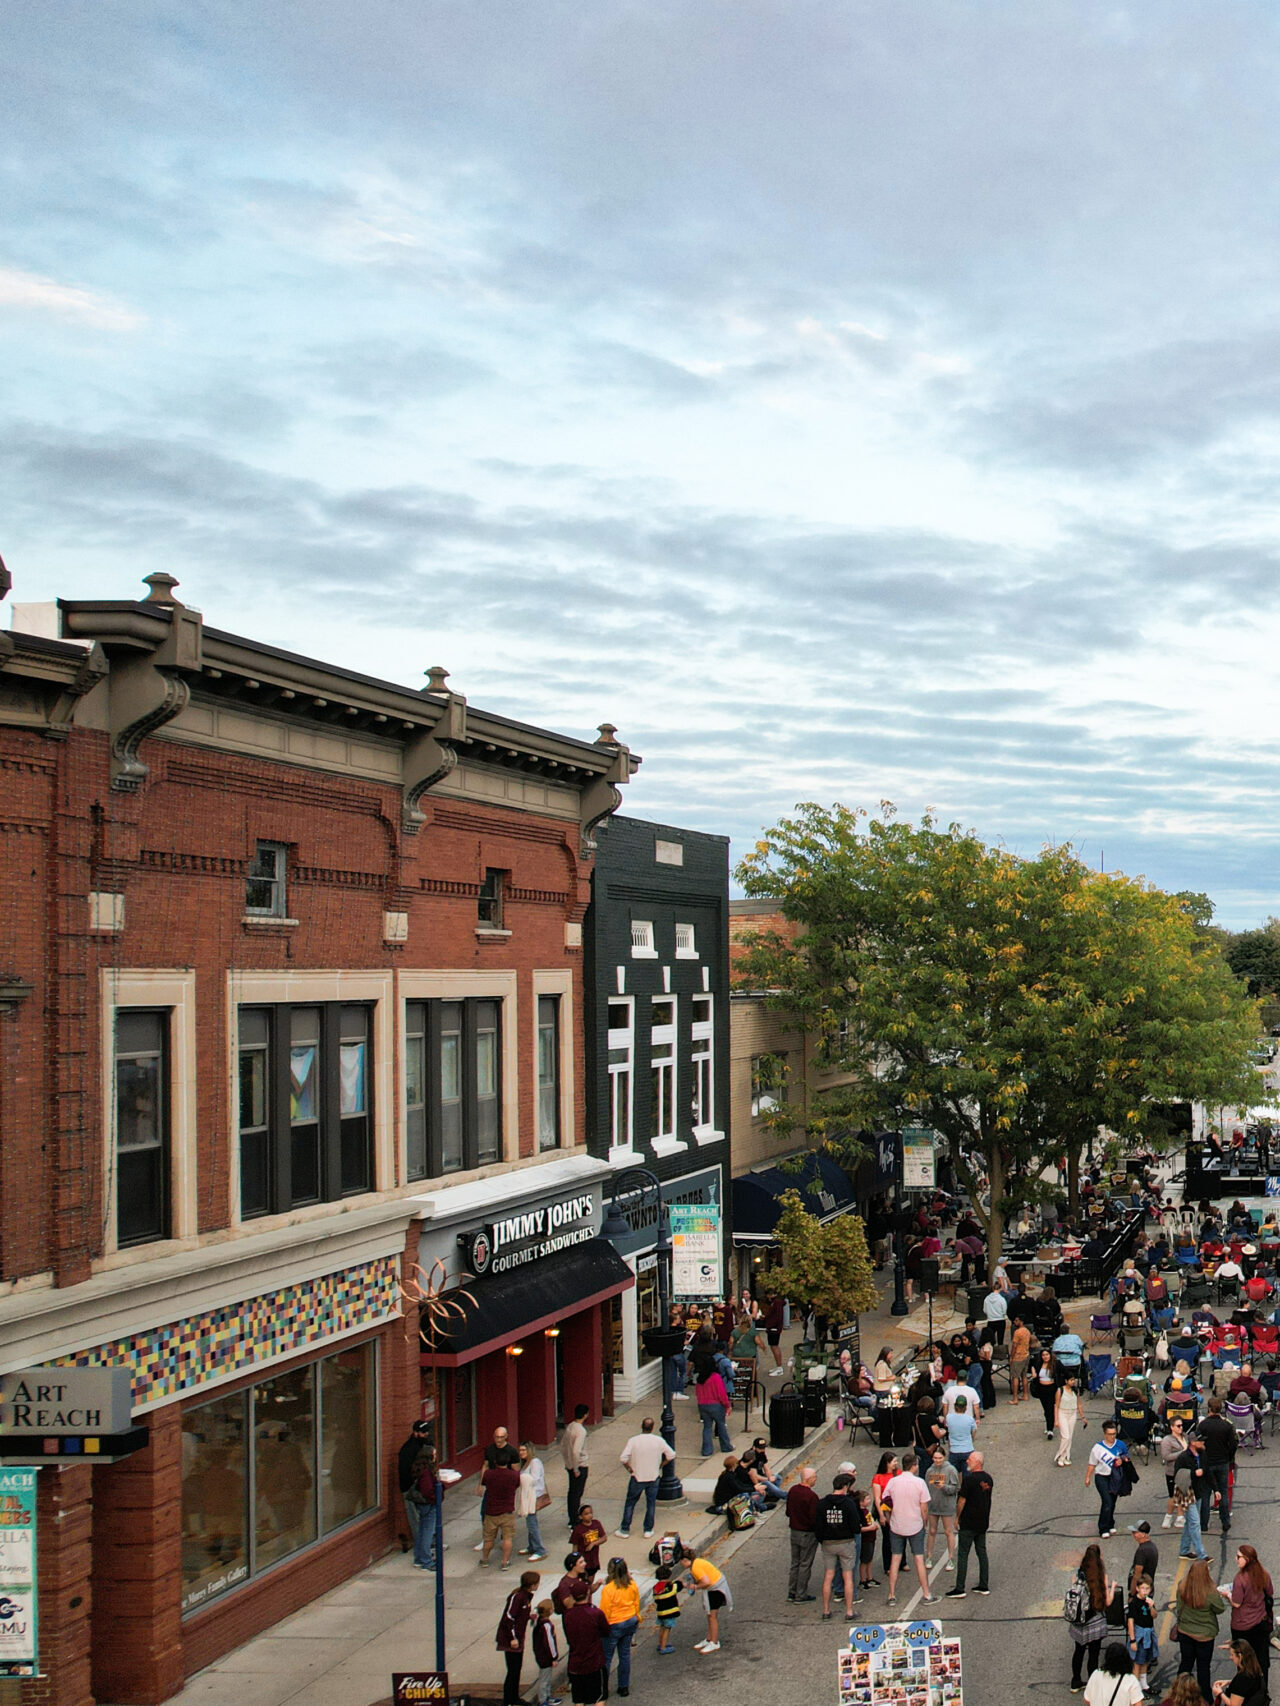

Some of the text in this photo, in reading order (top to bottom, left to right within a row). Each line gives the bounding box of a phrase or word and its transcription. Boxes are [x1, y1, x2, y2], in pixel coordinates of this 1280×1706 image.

[671, 1206, 717, 1215] ART REACH
[492, 1210, 545, 1254] JIMMY
[547, 1194, 593, 1236] JOHN'S
[491, 1243, 539, 1274] GOURMET
[540, 1226, 594, 1257] SANDWICHES
[11, 1380, 67, 1402] ART
[12, 1404, 101, 1427] REACH
[2, 1474, 33, 1486] ACH
[855, 1627, 940, 1643] CUB SCOUTS
[398, 1676, 442, 1693] Fire Up
[405, 1688, 446, 1699] CHIPS!
